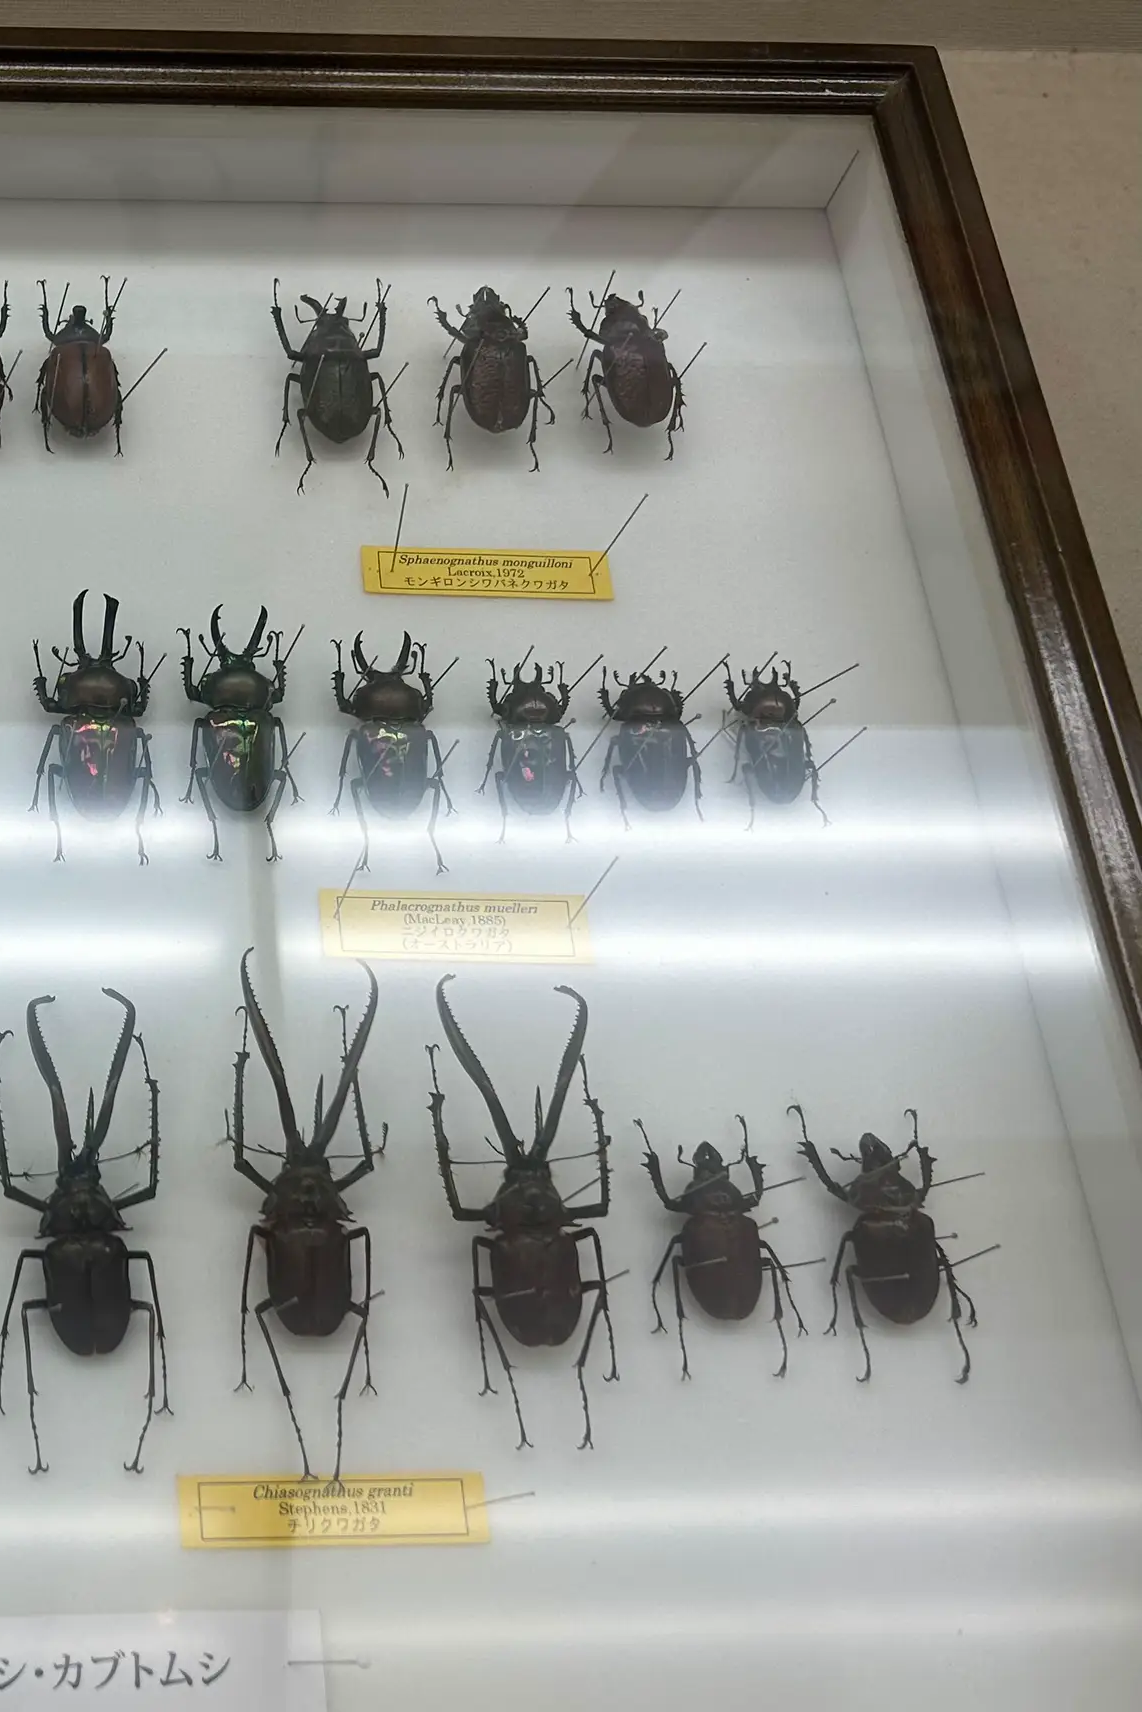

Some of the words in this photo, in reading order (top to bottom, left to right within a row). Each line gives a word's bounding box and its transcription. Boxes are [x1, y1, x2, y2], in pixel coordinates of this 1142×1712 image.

[398, 554, 499, 567] Sphaenognathus
[502, 557, 574, 569] monguilloni
[404, 576, 570, 591] モンギロンシワバネクワガタ
[370, 900, 480, 914] Phalacrognathus
[401, 926, 510, 939] ニジイロクワガタ
[253, 1484, 363, 1500] Chiasognathus
[368, 1483, 414, 1499] granti
[287, 1518, 381, 1533] チリクワガタ
